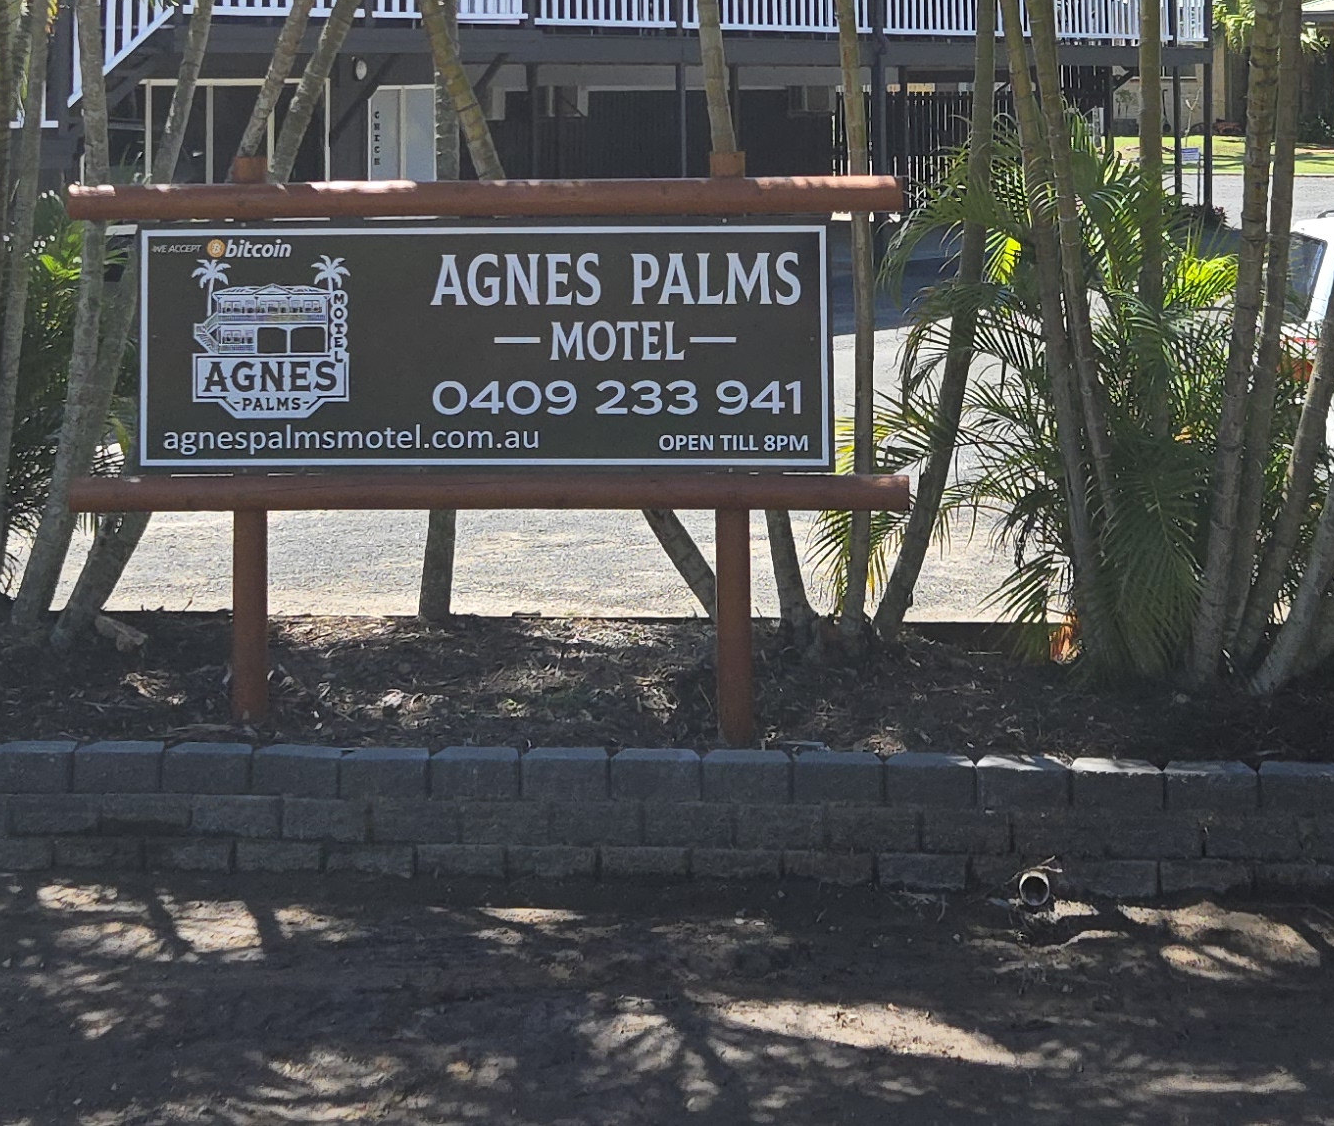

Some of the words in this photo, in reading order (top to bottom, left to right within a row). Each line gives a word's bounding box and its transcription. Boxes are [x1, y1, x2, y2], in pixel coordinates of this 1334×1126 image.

[151, 244, 167, 253] WE
[168, 244, 203, 253] ACCEPT
[225, 238, 292, 258] bitcoin
[430, 253, 602, 306] AGNES
[630, 252, 802, 306] PALMS
[334, 293, 345, 363] MOTEL
[549, 320, 686, 361] MOTEL
[202, 361, 338, 392] AGNES
[241, 397, 302, 411] PALMS
[432, 380, 578, 415] 0409
[595, 380, 699, 415] 233
[715, 380, 802, 415] 941
[163, 424, 540, 455] agnespalmsmotel.com.au
[658, 434, 714, 451] OPEN
[719, 434, 759, 451] TILL
[763, 434, 809, 451] 8PM
